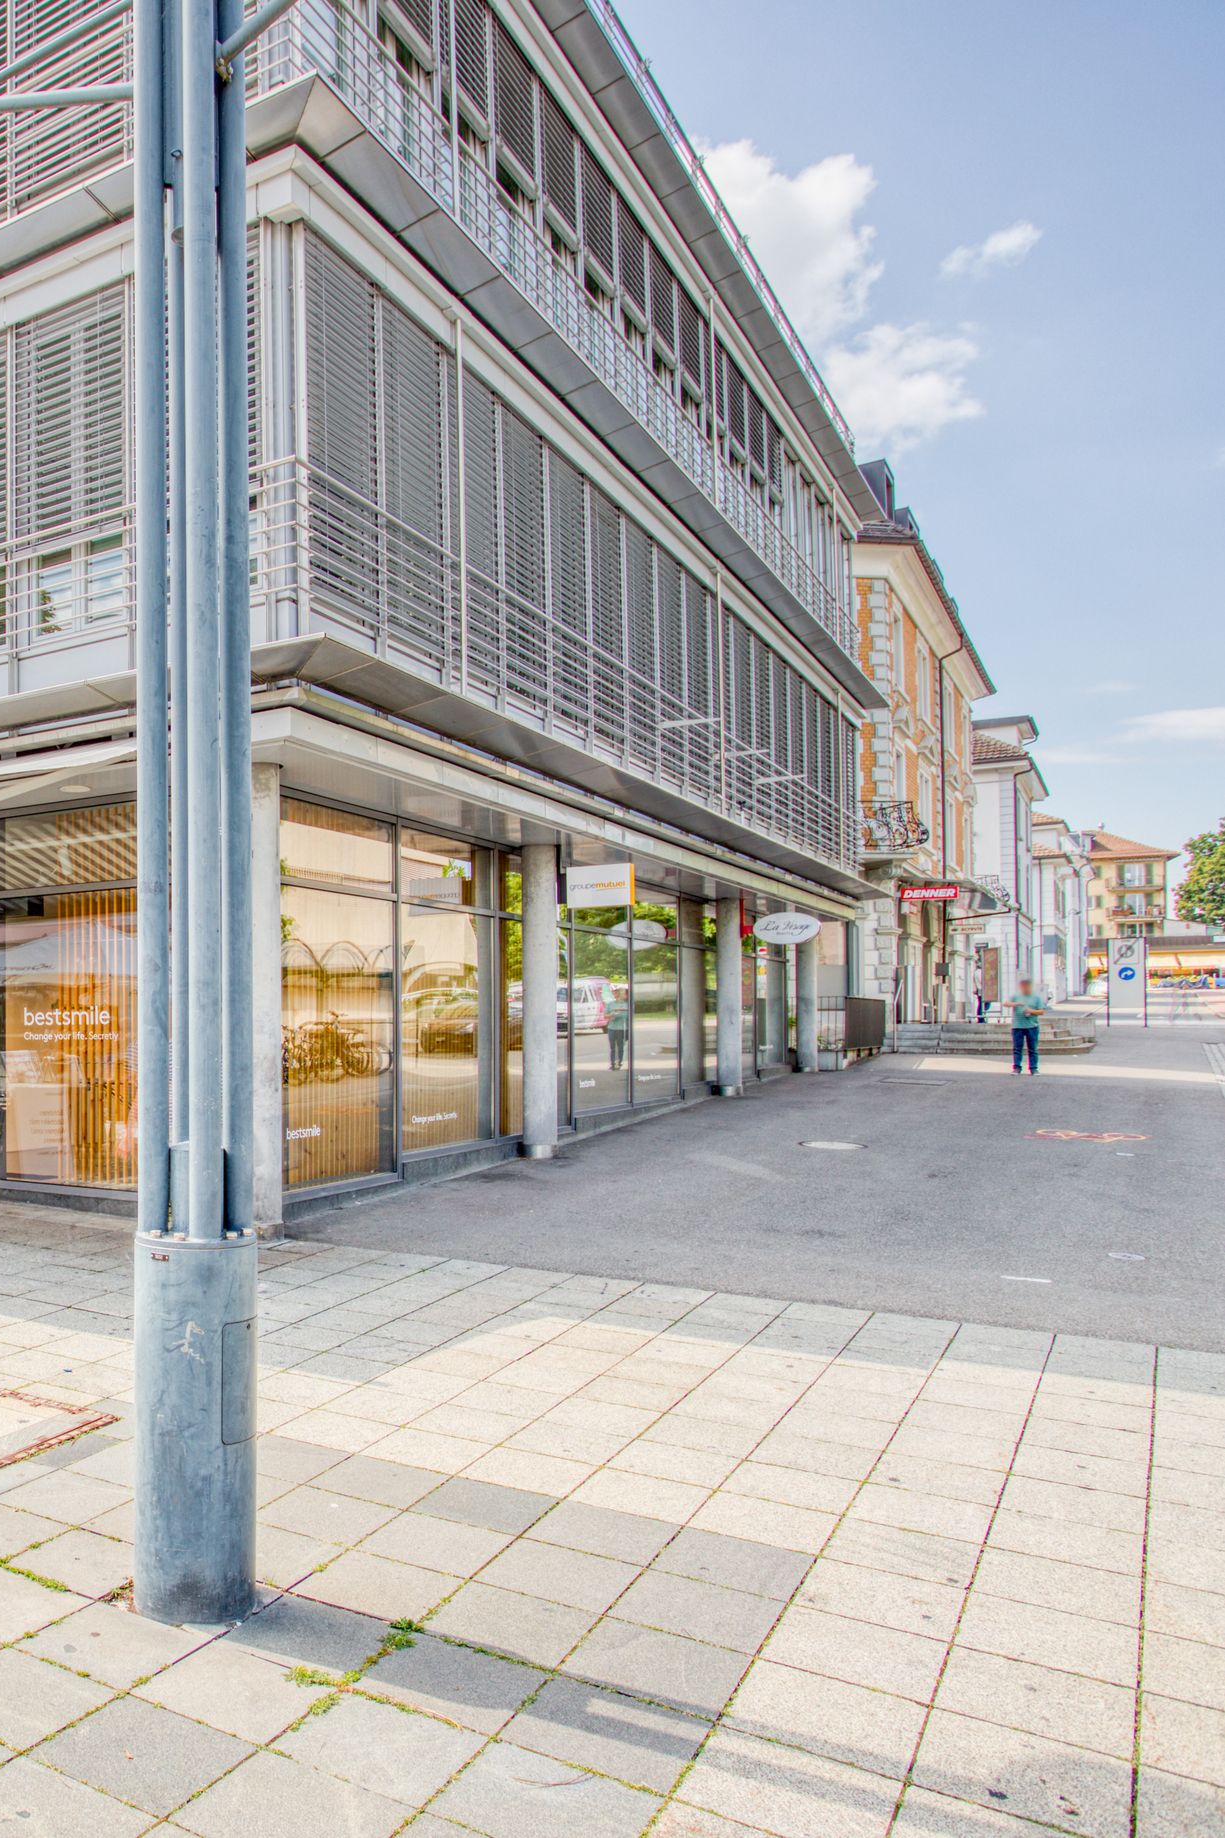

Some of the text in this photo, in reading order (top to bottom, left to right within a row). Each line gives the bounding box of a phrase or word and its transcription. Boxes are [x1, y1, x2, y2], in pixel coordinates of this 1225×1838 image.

[569, 880, 626, 892] groupemutuel
[903, 888, 956, 899] DENNER
[23, 1005, 110, 1026] bestsmile
[23, 1031, 119, 1043] Change your life. Secretly
[286, 1124, 321, 1140] bestsmile
